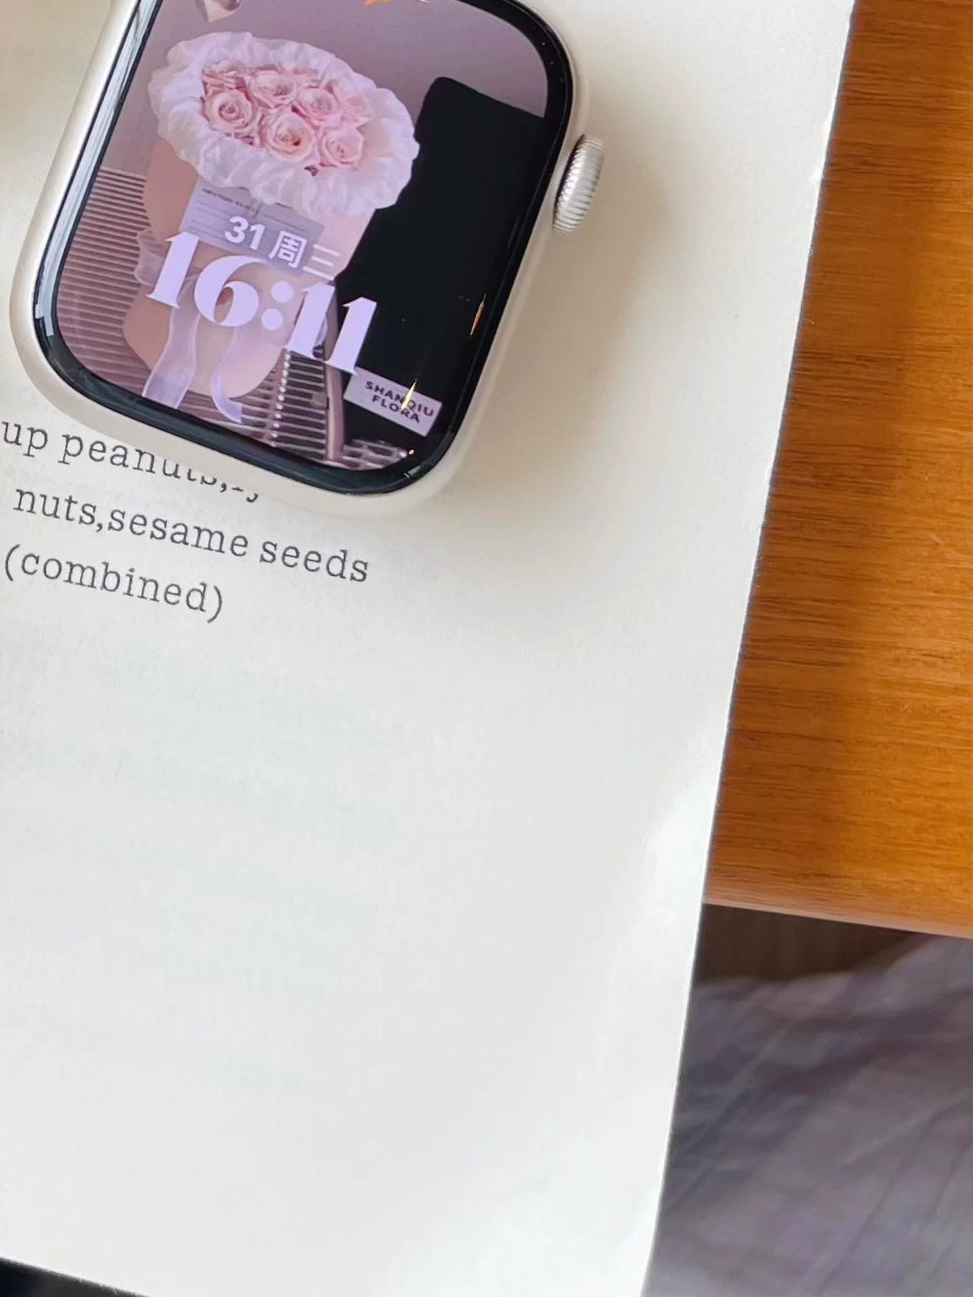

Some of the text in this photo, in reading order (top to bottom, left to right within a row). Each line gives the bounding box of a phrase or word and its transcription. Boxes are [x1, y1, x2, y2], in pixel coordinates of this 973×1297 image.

[223, 214, 342, 282] 31 周三
[146, 230, 378, 377] 16:11
[371, 393, 421, 424] FLORA
[4, 543, 223, 624] (combined)
[258, 540, 369, 583] seeds
